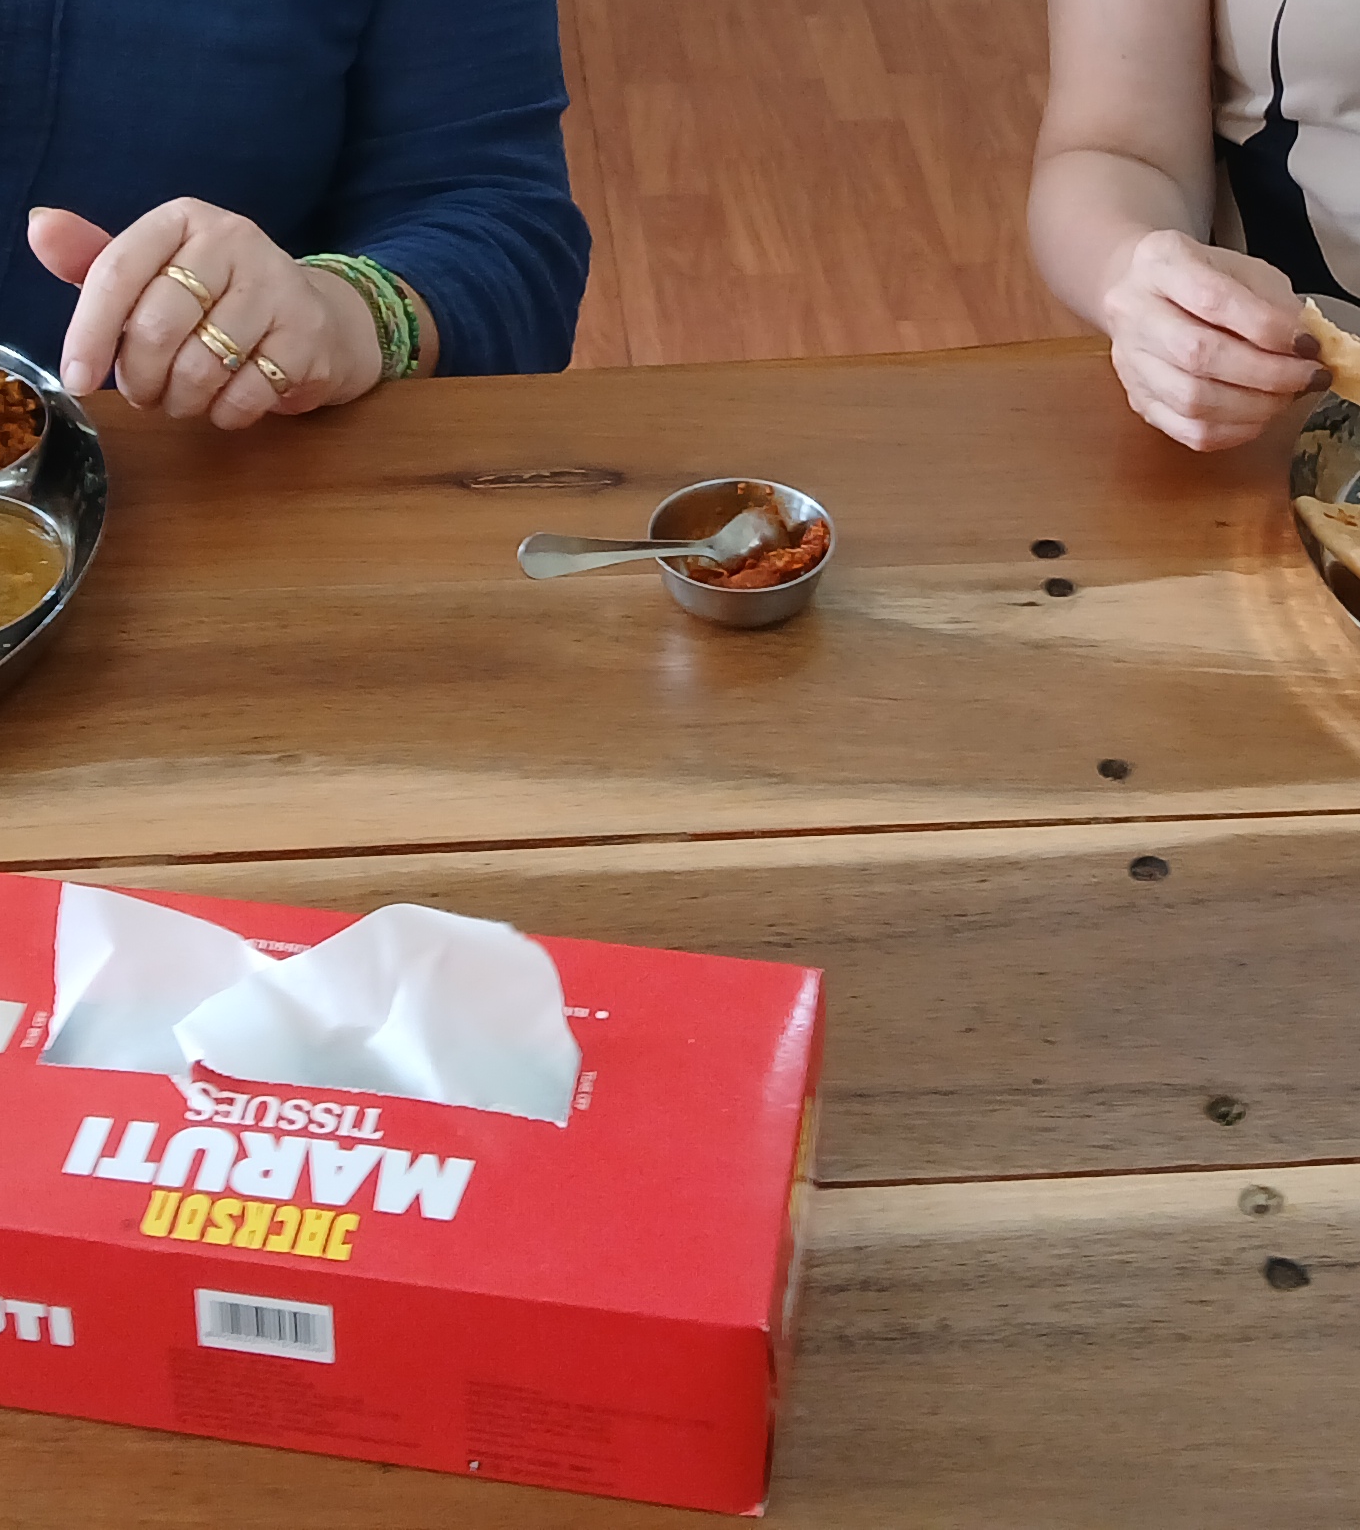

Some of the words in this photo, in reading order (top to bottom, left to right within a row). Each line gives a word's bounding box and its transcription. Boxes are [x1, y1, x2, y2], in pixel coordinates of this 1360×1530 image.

[184, 1081, 384, 1139] TISSUES
[61, 1116, 476, 1221] MARUTI
[140, 1190, 360, 1261] JACKSON
